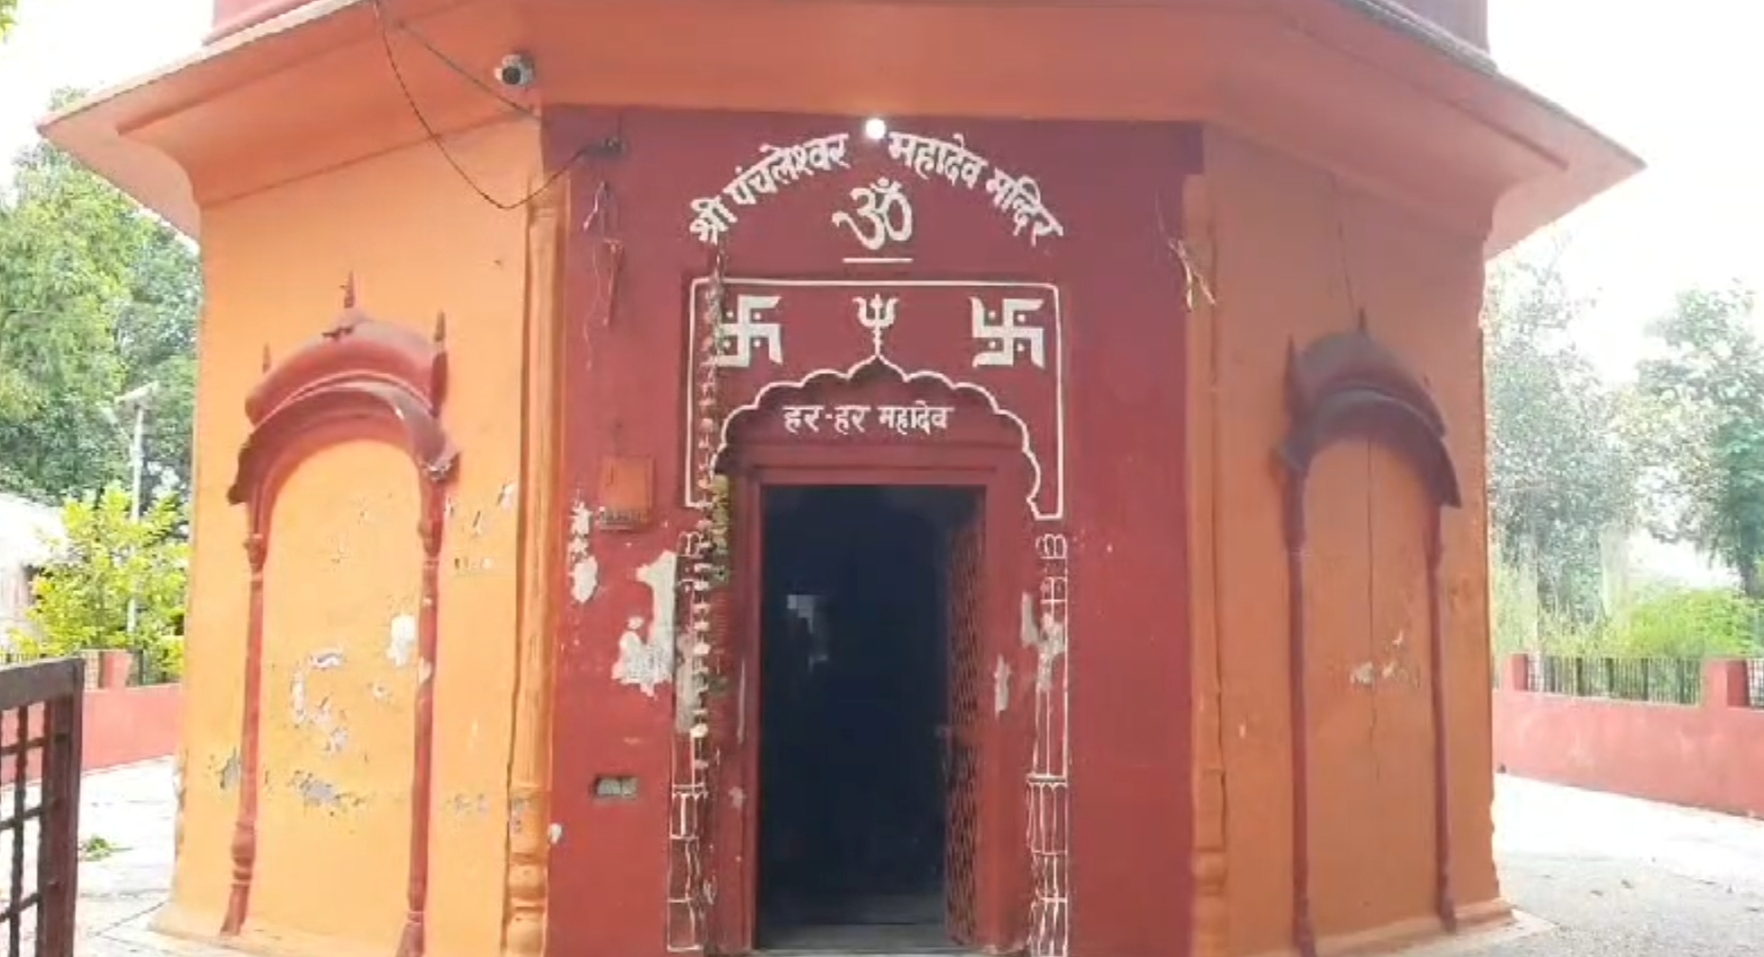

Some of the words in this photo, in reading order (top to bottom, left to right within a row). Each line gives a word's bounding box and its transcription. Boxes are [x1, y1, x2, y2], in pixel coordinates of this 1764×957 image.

[689, 196, 738, 245] श्री
[888, 131, 988, 190] महादेव
[985, 167, 1063, 246] मन्दिर
[832, 177, 913, 250] ॐ
[878, 400, 954, 435] महादेव
